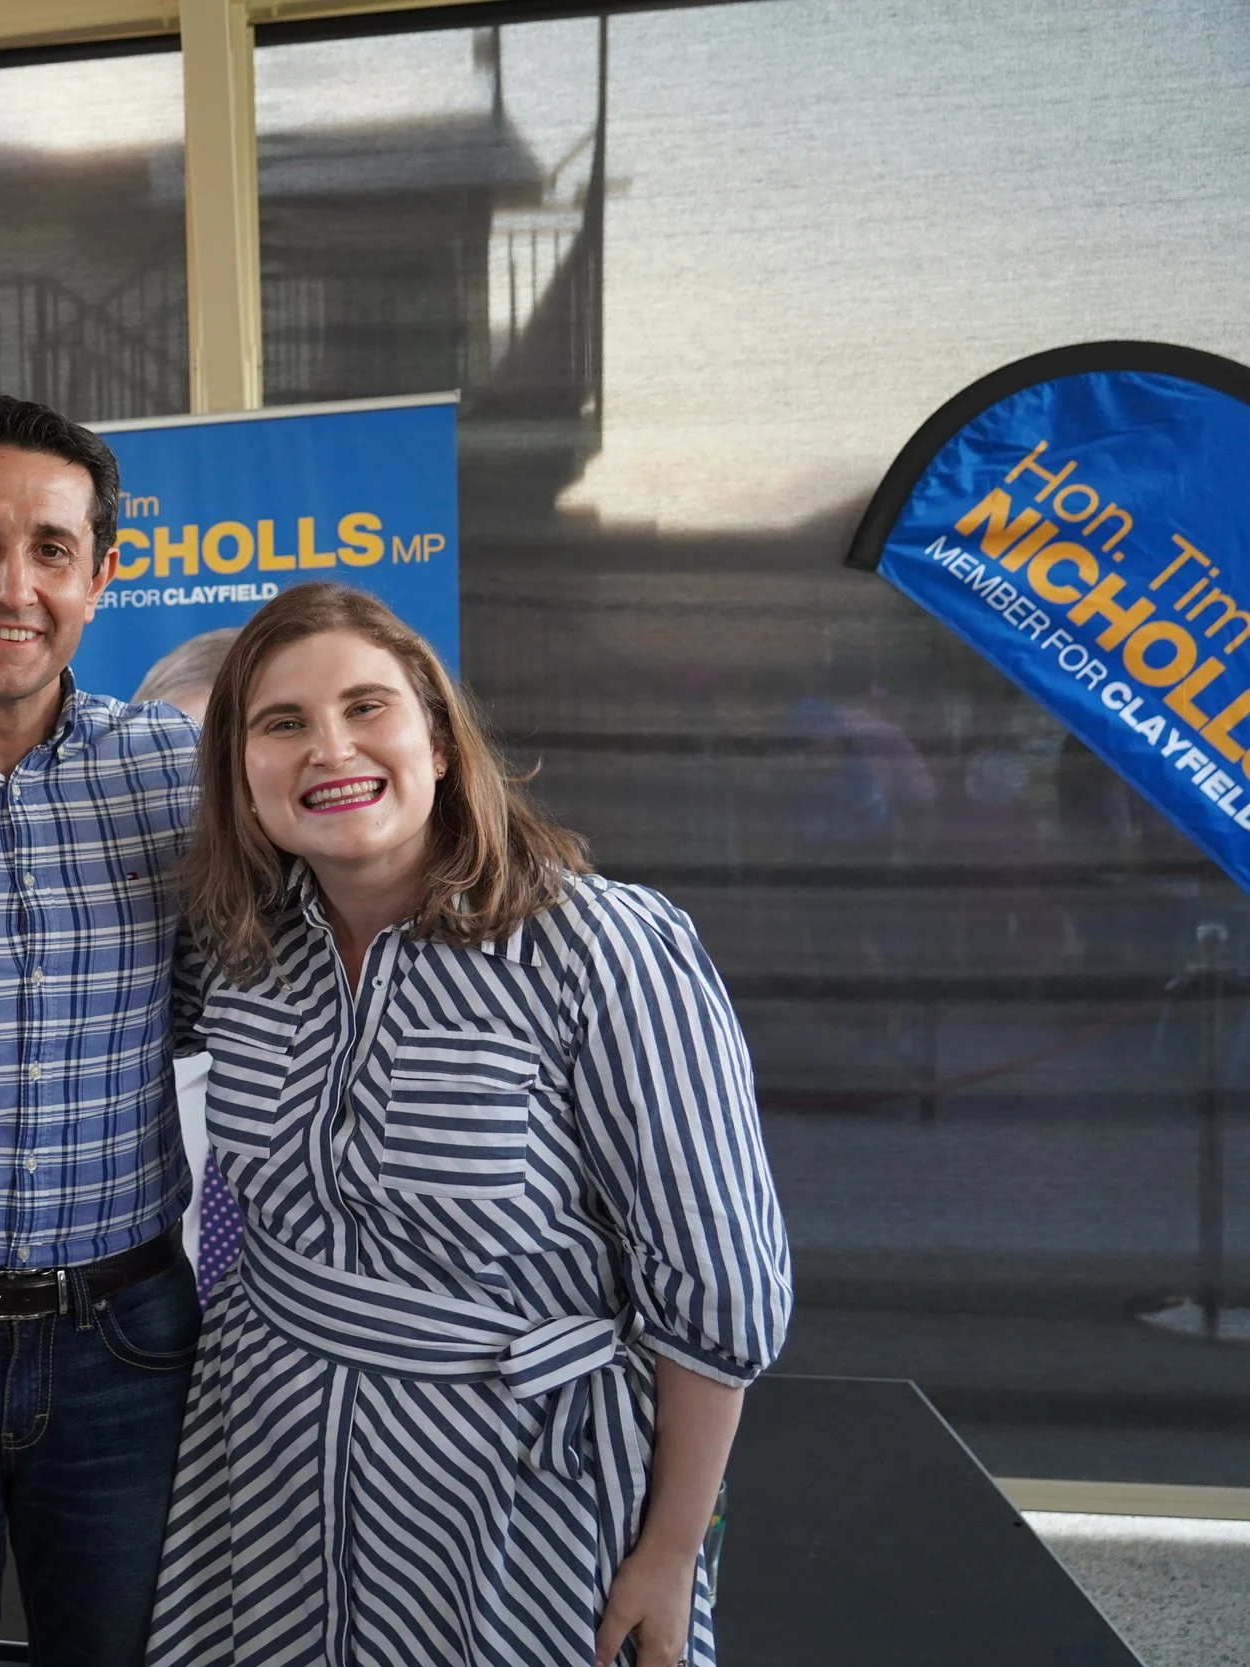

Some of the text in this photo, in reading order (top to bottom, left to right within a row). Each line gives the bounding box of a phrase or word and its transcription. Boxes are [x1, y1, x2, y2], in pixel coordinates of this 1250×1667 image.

[114, 512, 446, 580] CHOLLS MP
[120, 589, 161, 609] FOR
[162, 582, 279, 606] CLAYFIELD
[1004, 440, 1250, 655] Hon. Tim
[924, 535, 1050, 641] MEMBER
[1040, 628, 1108, 691] FOR
